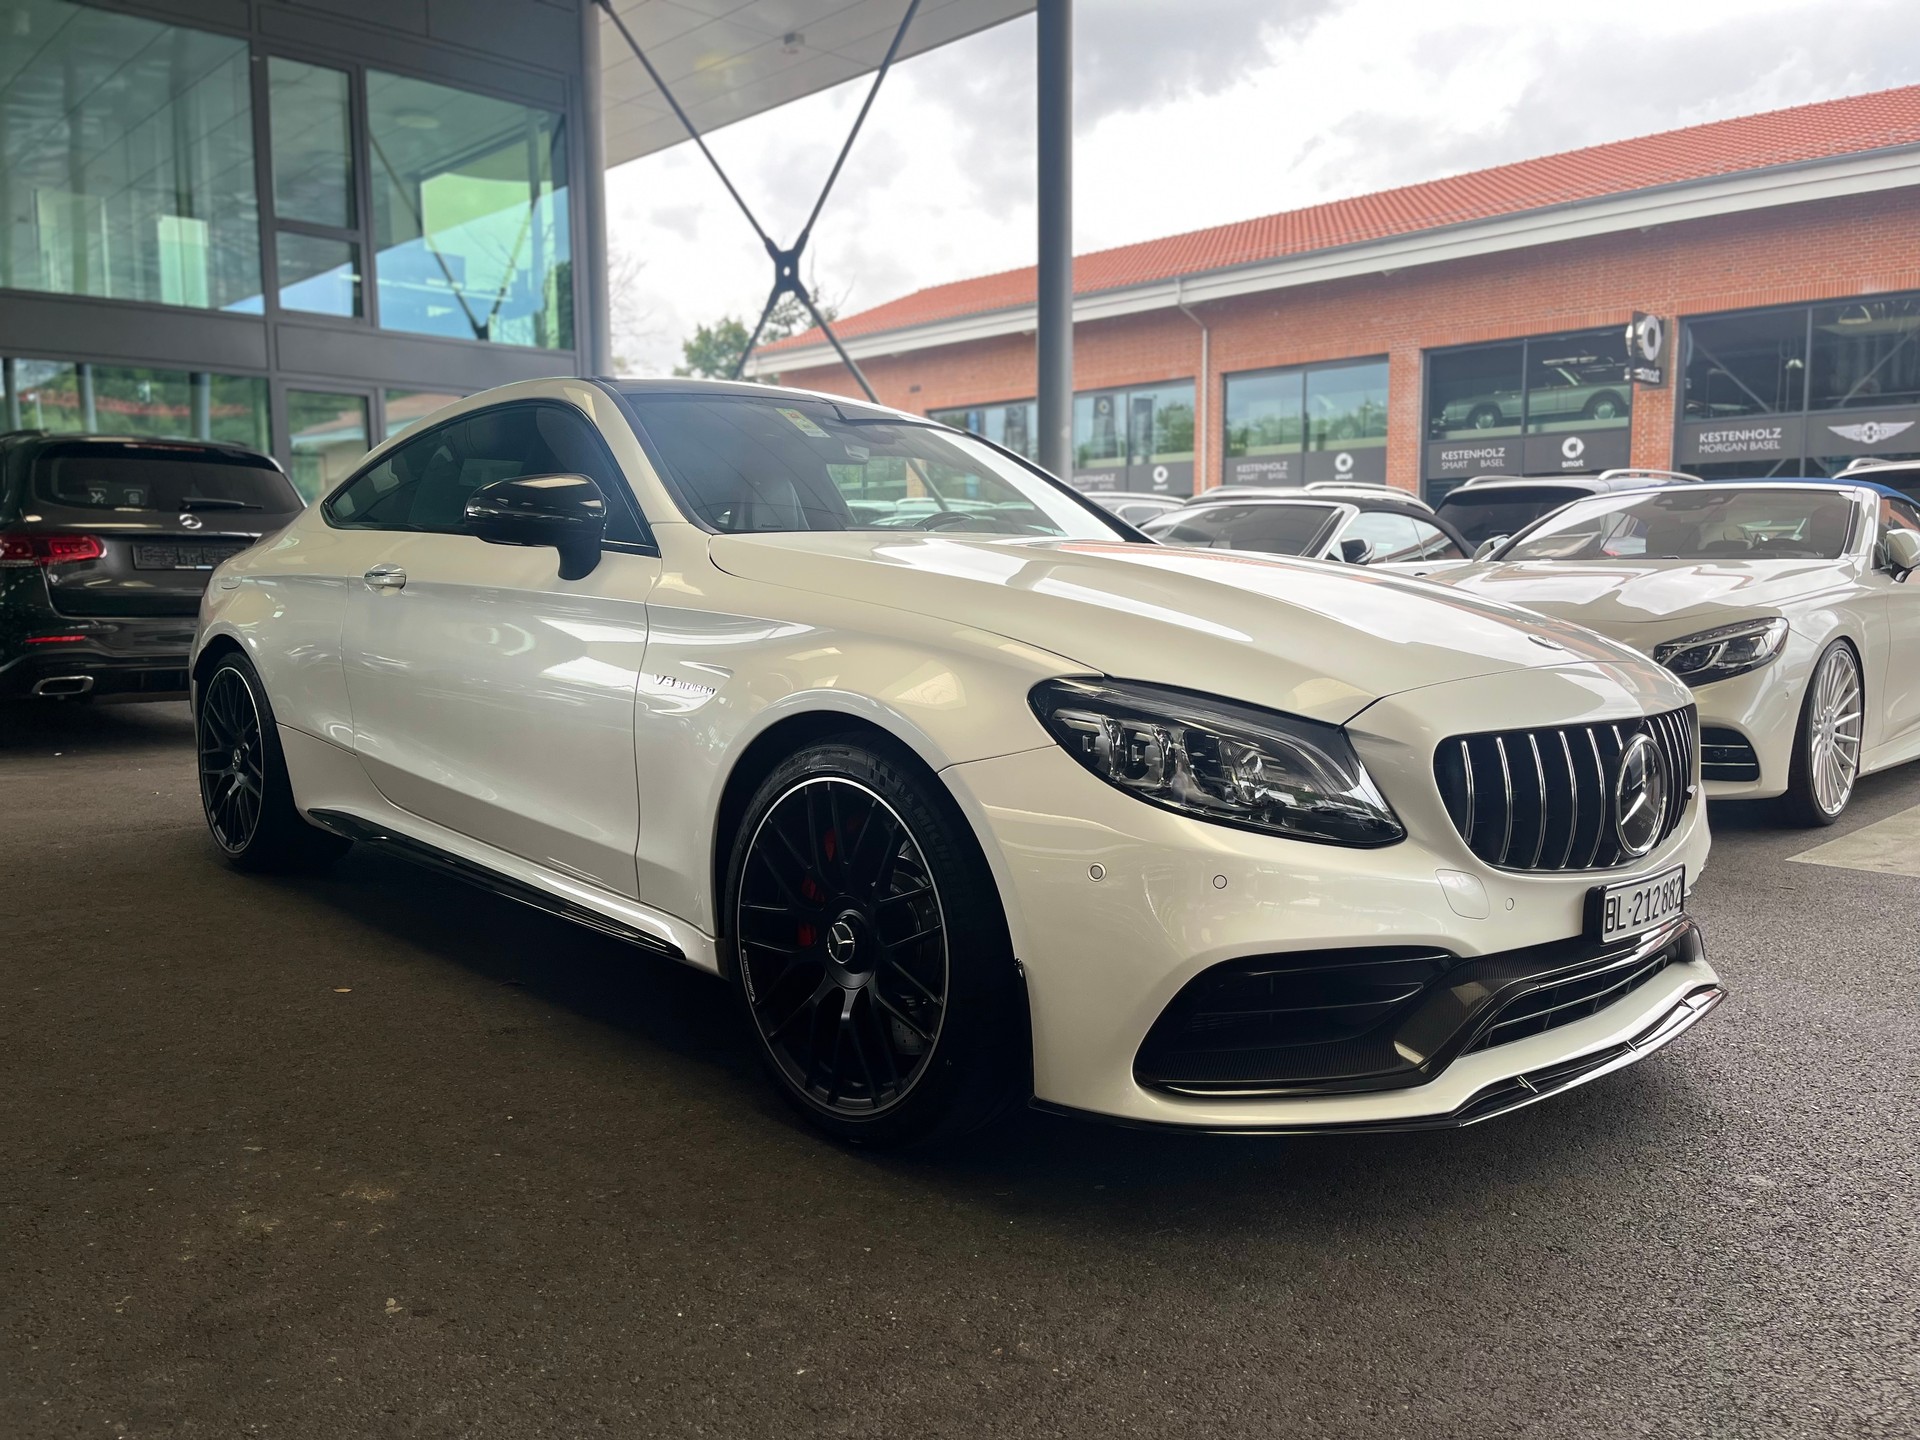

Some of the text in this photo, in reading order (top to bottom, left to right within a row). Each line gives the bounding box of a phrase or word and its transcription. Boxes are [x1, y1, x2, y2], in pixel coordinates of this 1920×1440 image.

[1637, 367, 1660, 383] smart
[1699, 427, 1782, 443] KESTENHOLZ
[1699, 440, 1781, 453] MORGAN BASEL
[1441, 447, 1505, 460] KESTENHOLZ
[1441, 459, 1504, 470] SMART BASEL
[1561, 459, 1584, 468] smart
[653, 674, 716, 695] V8 BITURBO
